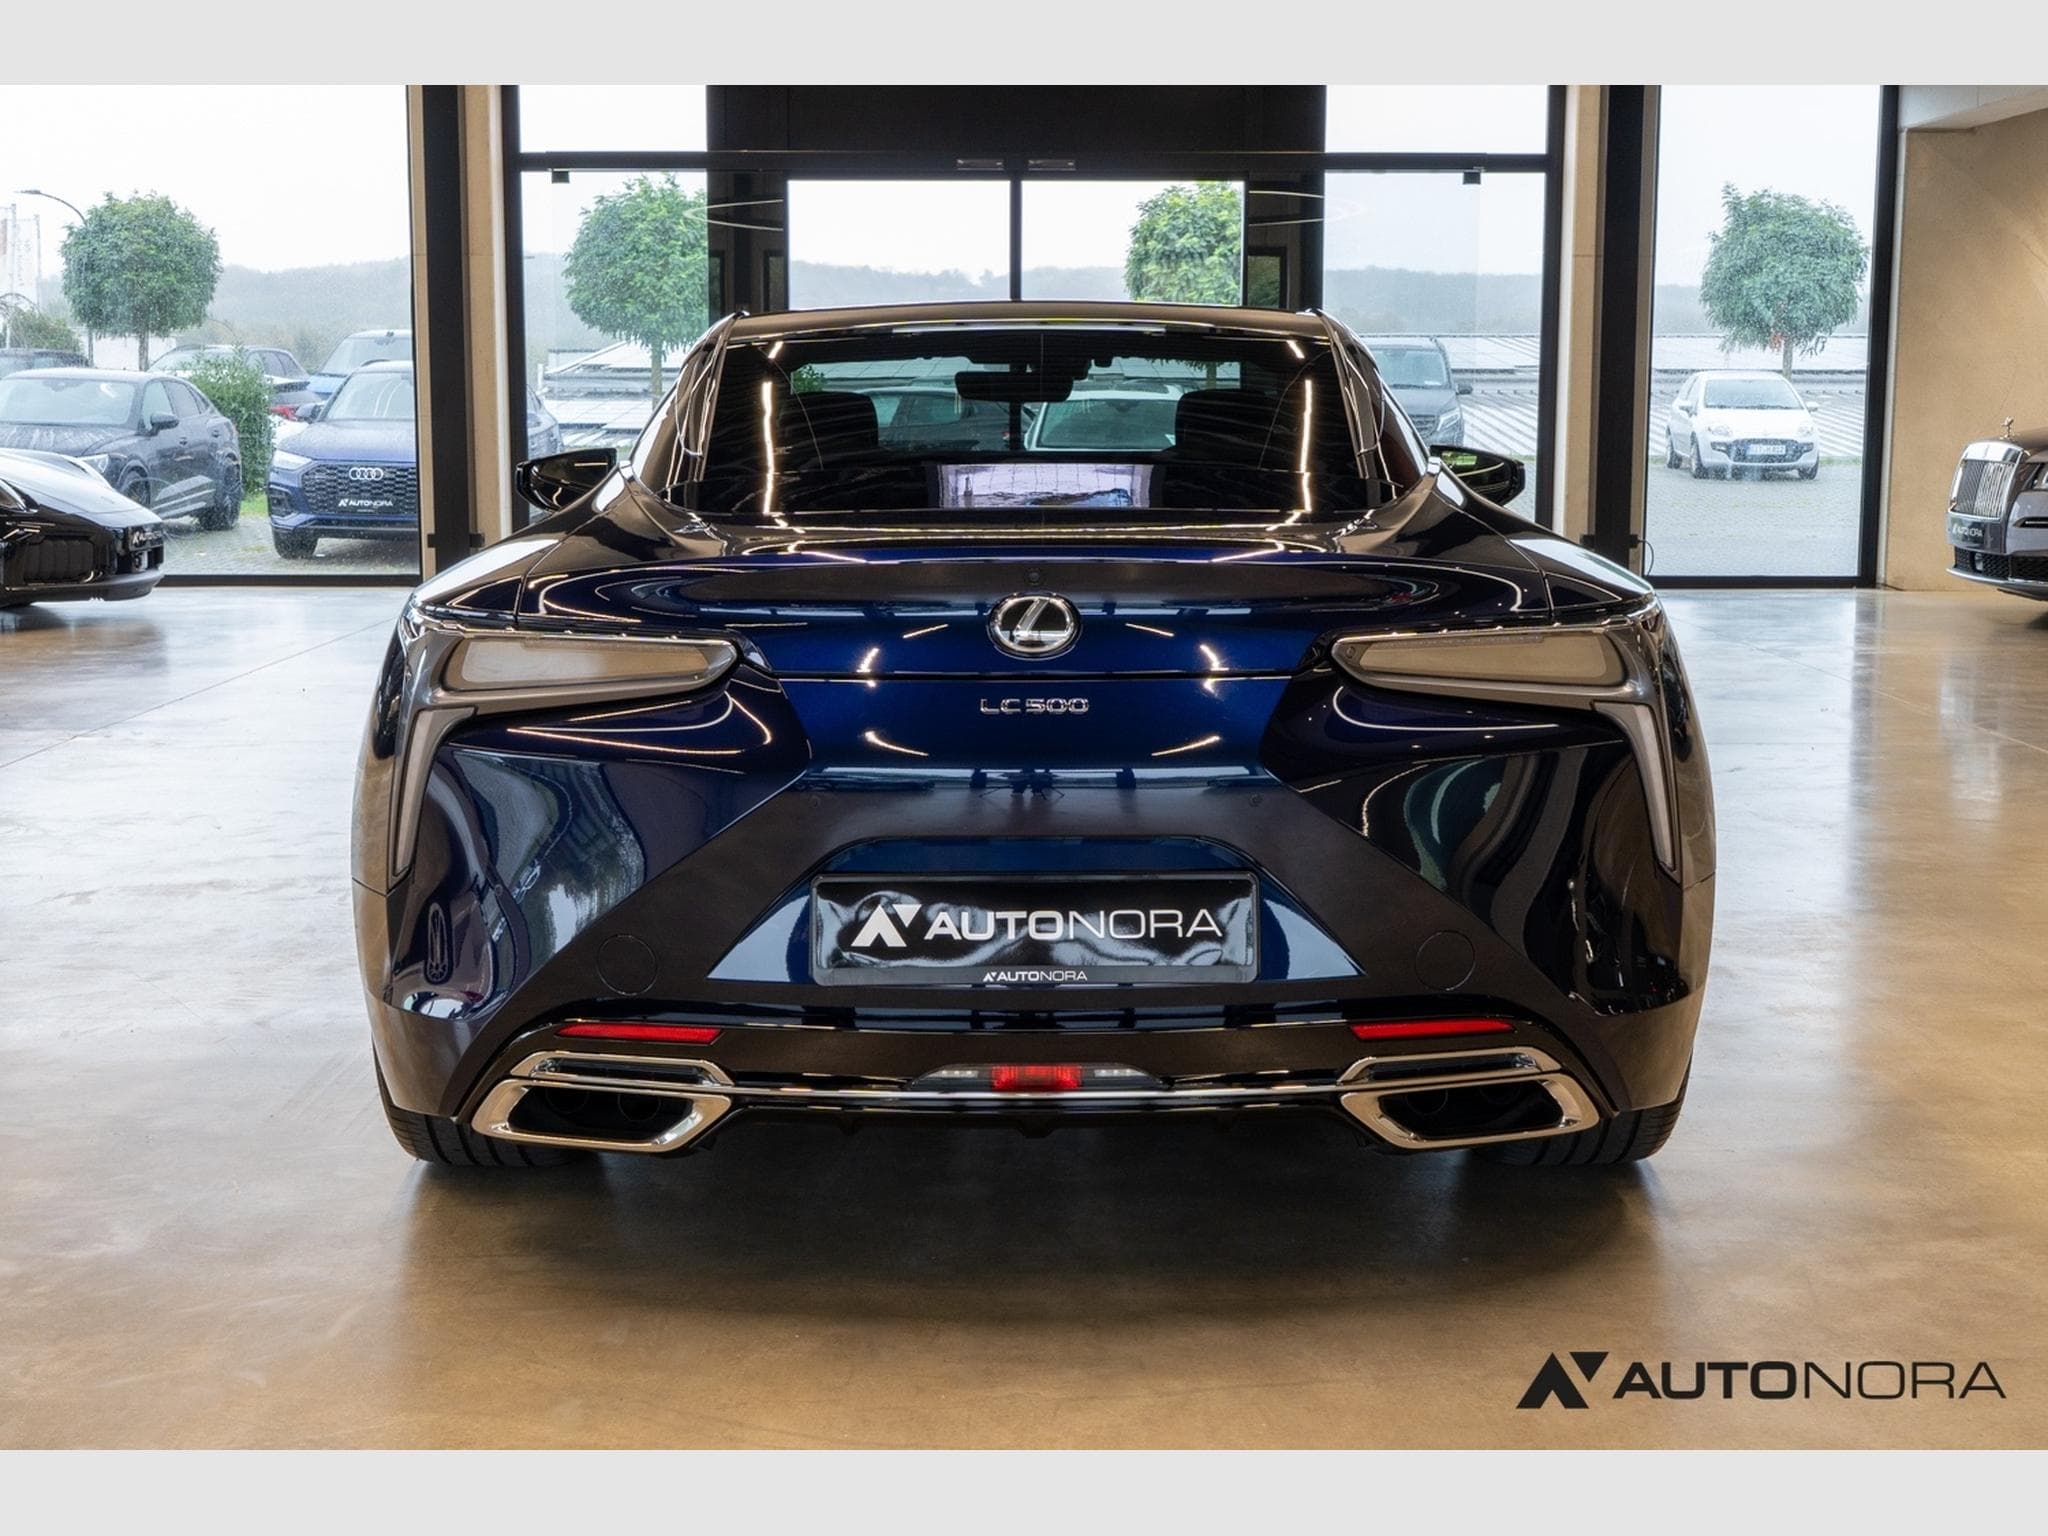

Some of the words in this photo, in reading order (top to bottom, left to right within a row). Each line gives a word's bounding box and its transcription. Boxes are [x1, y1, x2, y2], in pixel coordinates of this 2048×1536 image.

[980, 698, 1021, 714] LC
[1025, 697, 1089, 714] 500
[924, 908, 1224, 942] AUTONORA
[996, 970, 1088, 982] AUTONORA
